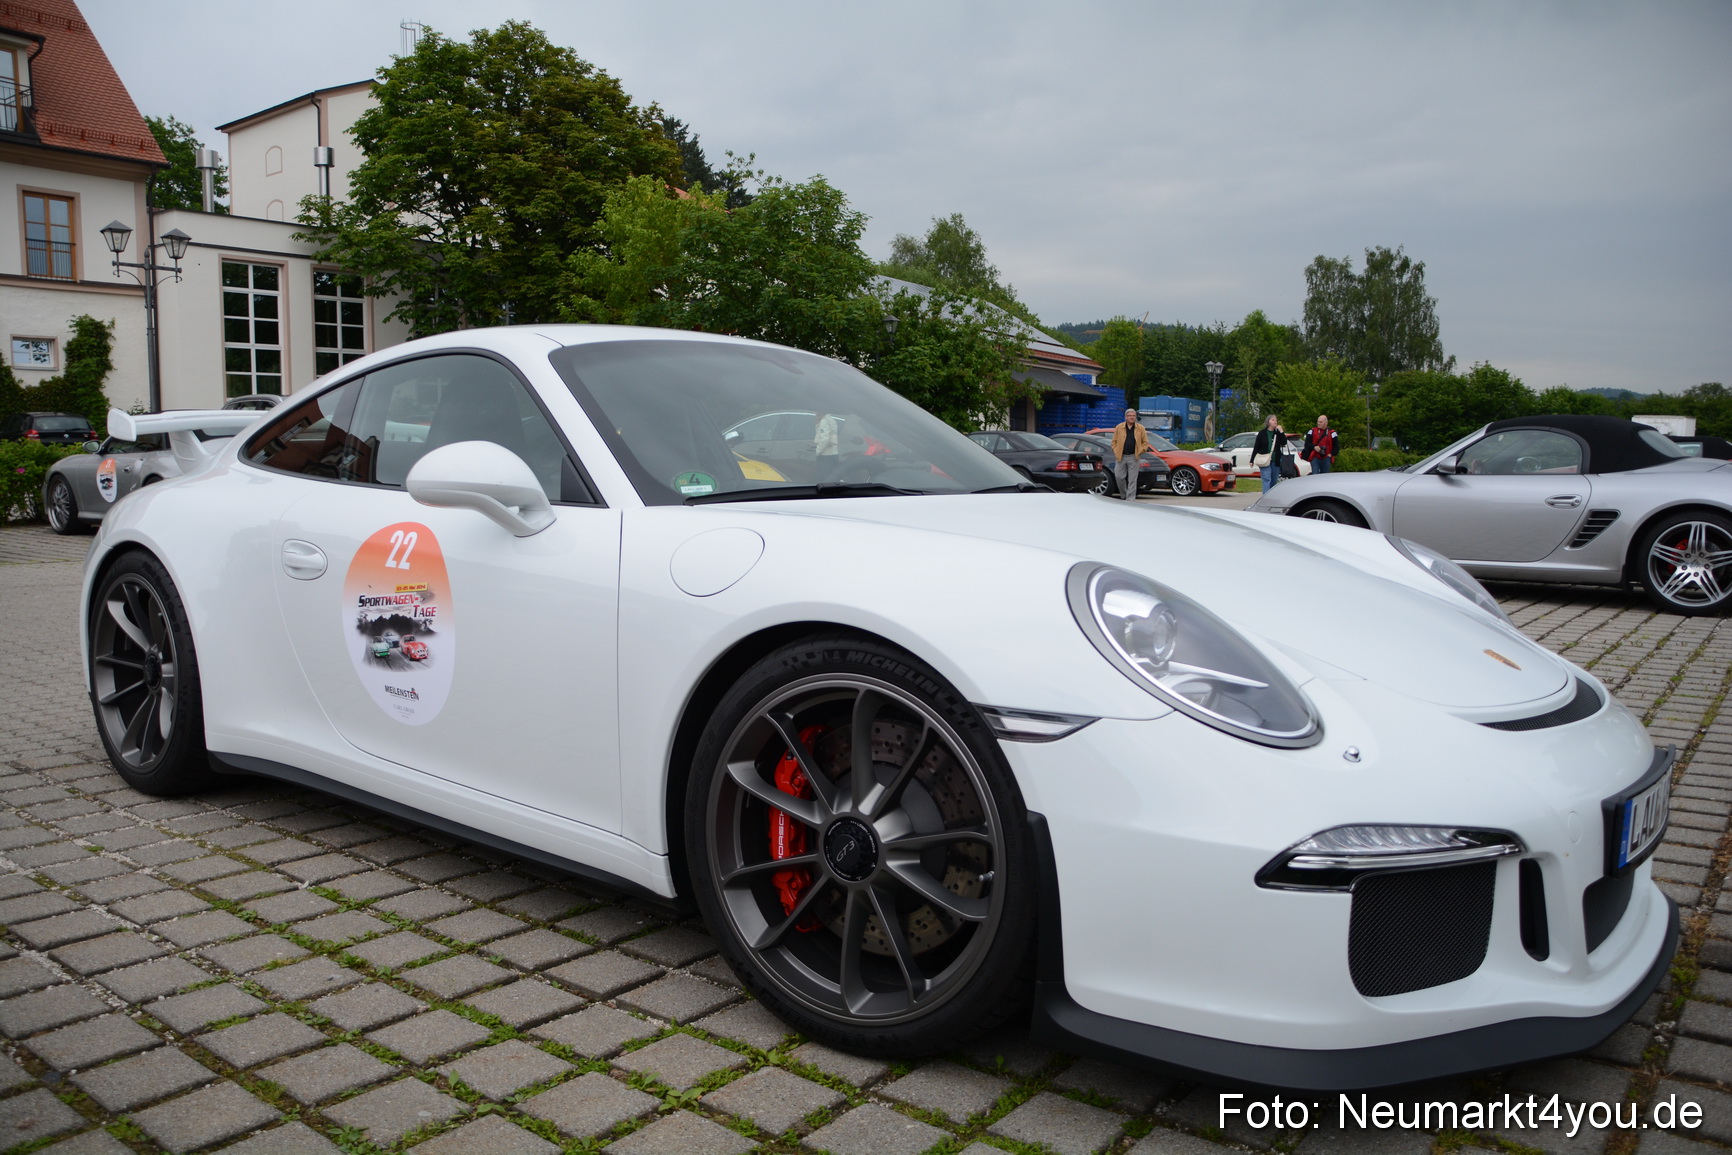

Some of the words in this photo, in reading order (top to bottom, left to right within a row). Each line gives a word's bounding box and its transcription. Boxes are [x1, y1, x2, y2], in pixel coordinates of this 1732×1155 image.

[689, 473, 701, 485] 4
[385, 529, 418, 570] 22
[845, 650, 940, 696] MICHELIN
[384, 684, 420, 701] MEILENSTEIN
